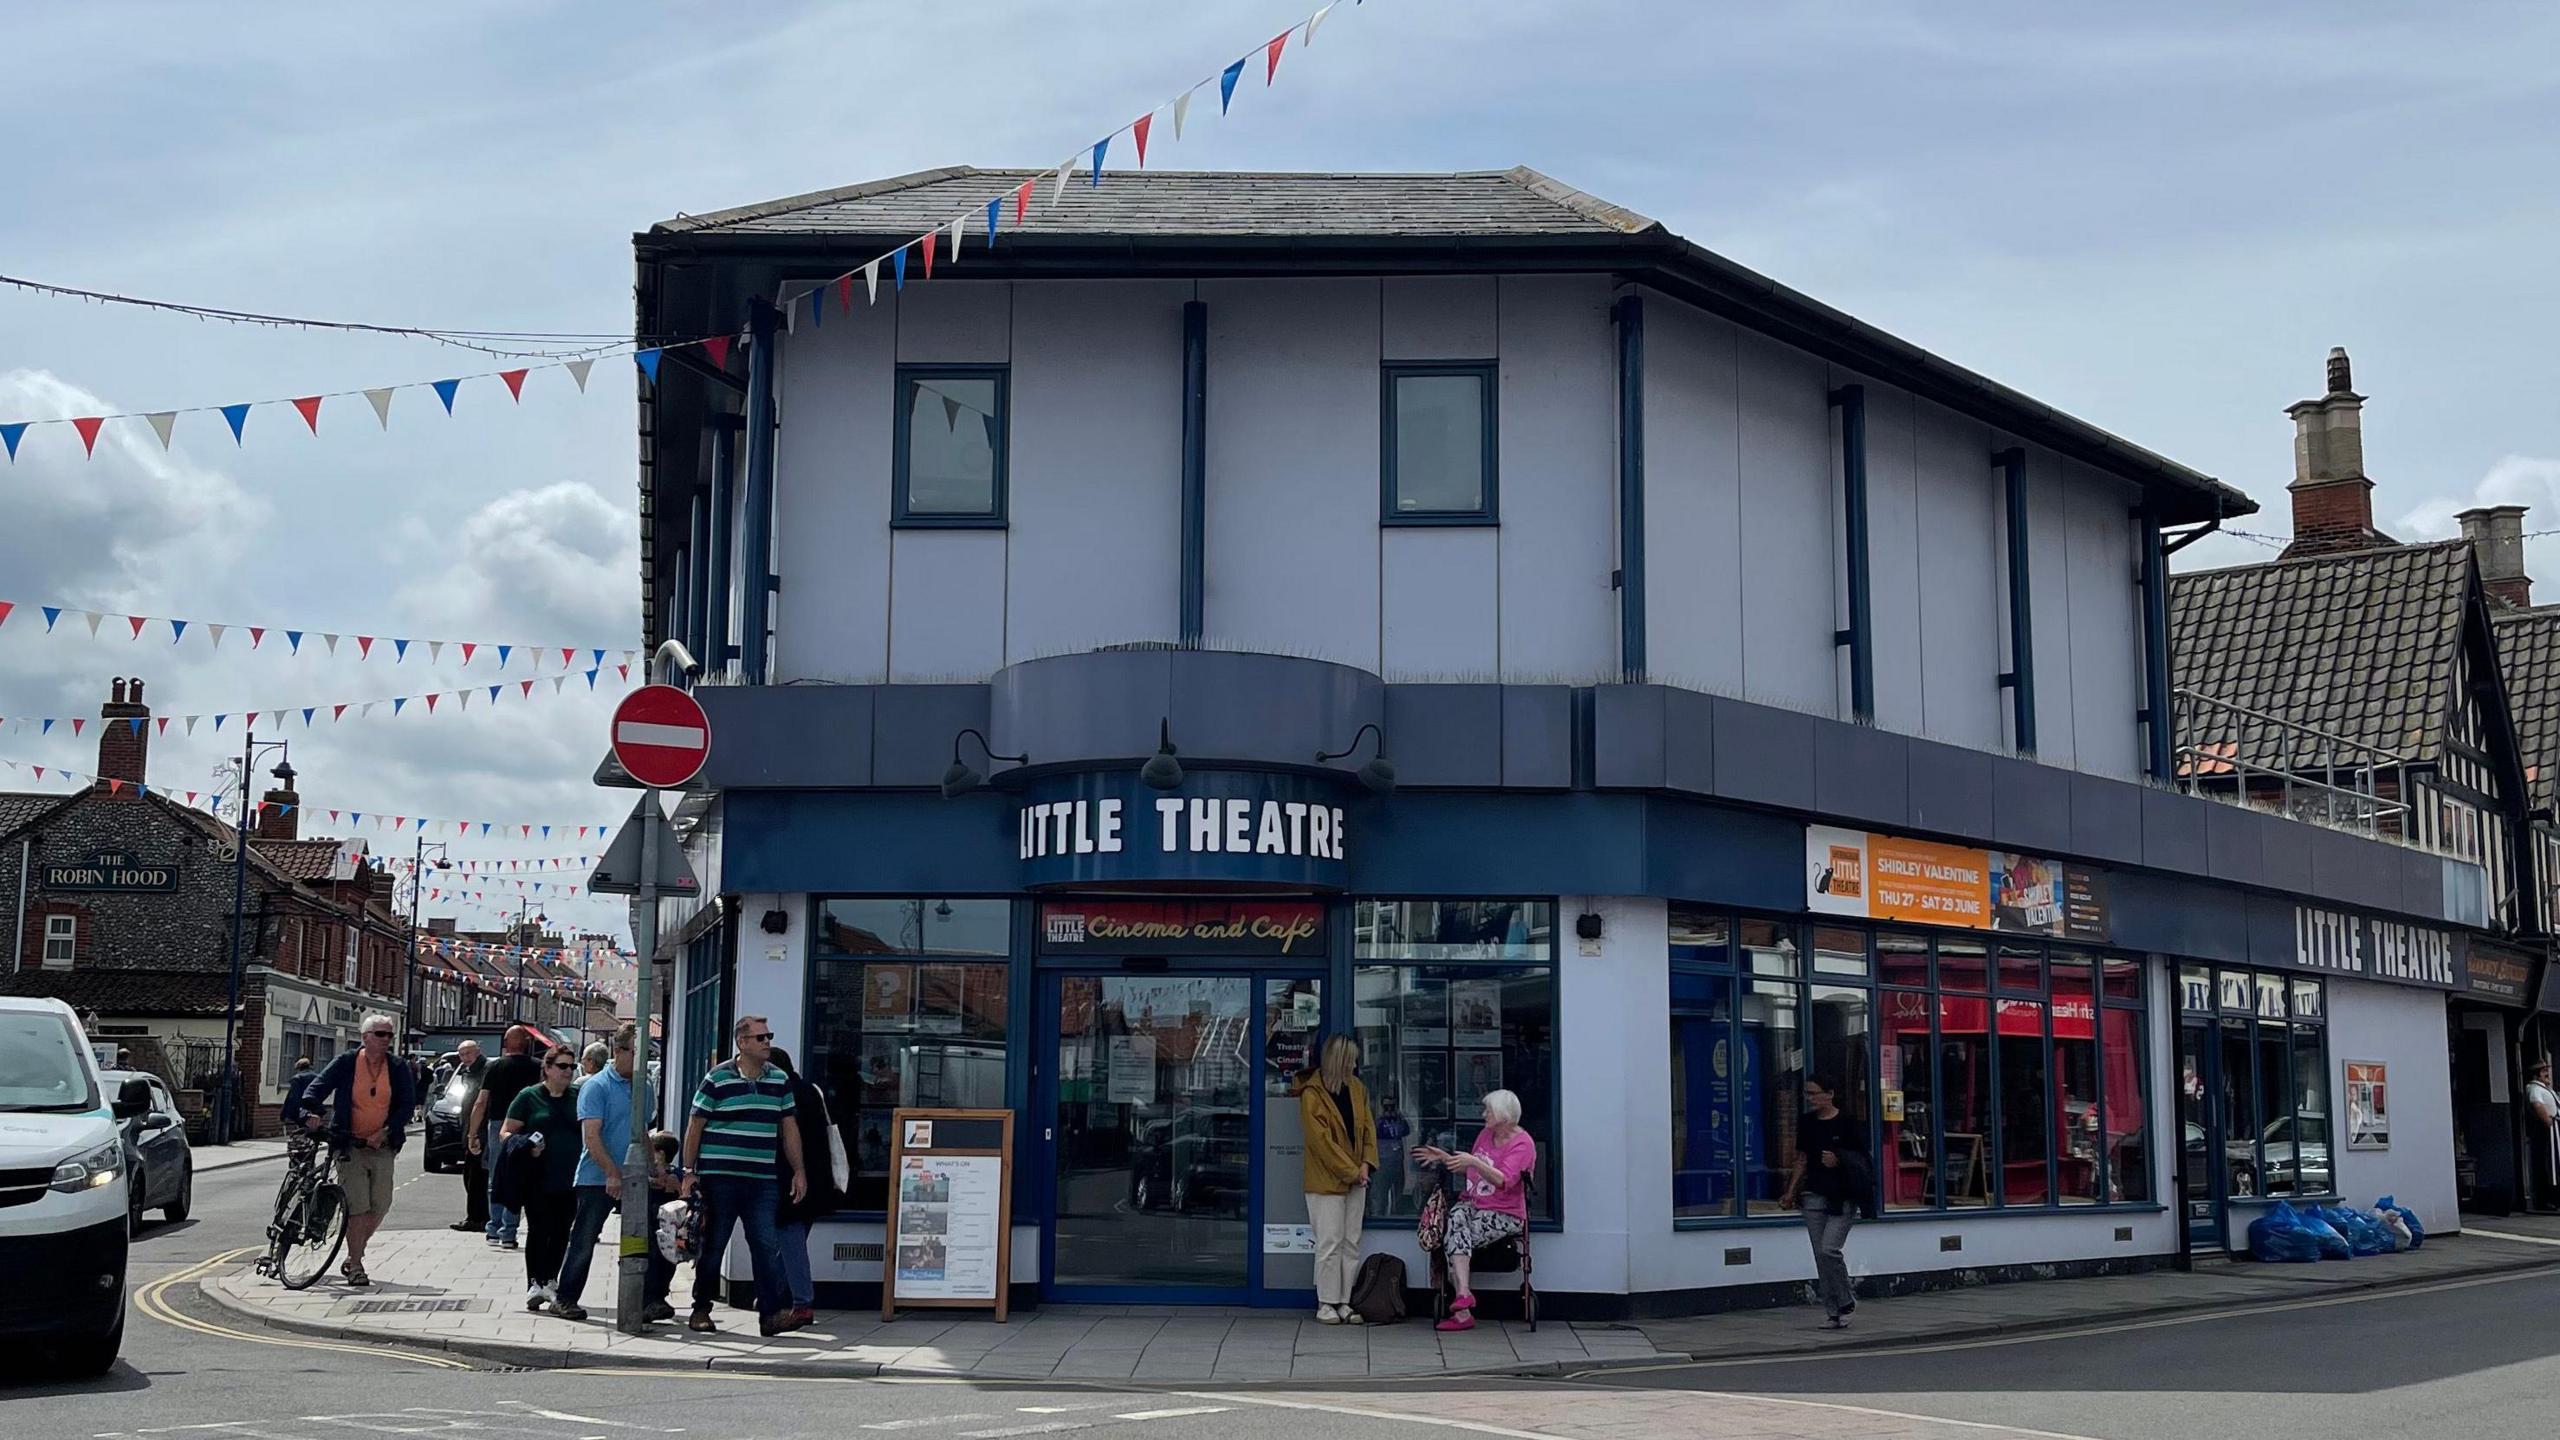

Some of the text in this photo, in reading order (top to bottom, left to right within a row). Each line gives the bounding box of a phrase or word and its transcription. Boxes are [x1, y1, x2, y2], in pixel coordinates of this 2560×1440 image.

[1020, 798, 1344, 861] LITTLE THEATRE
[98, 855, 125, 866] THE
[1832, 858, 1860, 881] LITTLE
[50, 868, 168, 886] ROBIN HOOD
[1877, 857, 1980, 885] SHIRLEY VALENTINE
[1832, 878, 1860, 895] THEATRE
[1878, 889, 1900, 907] THU
[1902, 892, 1915, 908] 27
[1921, 894, 1941, 912] SAT
[1941, 897, 1954, 912] 29
[1954, 899, 1981, 915] JUNE
[1047, 920, 1085, 933] LITTLE
[1088, 913, 1316, 953] Cinema and Café
[1047, 932, 1085, 943] THEATRE
[2296, 906, 2453, 984] LITTLE THEATRE
[1277, 1043, 1308, 1051] Theatr
[1277, 1056, 1308, 1064] Cinem
